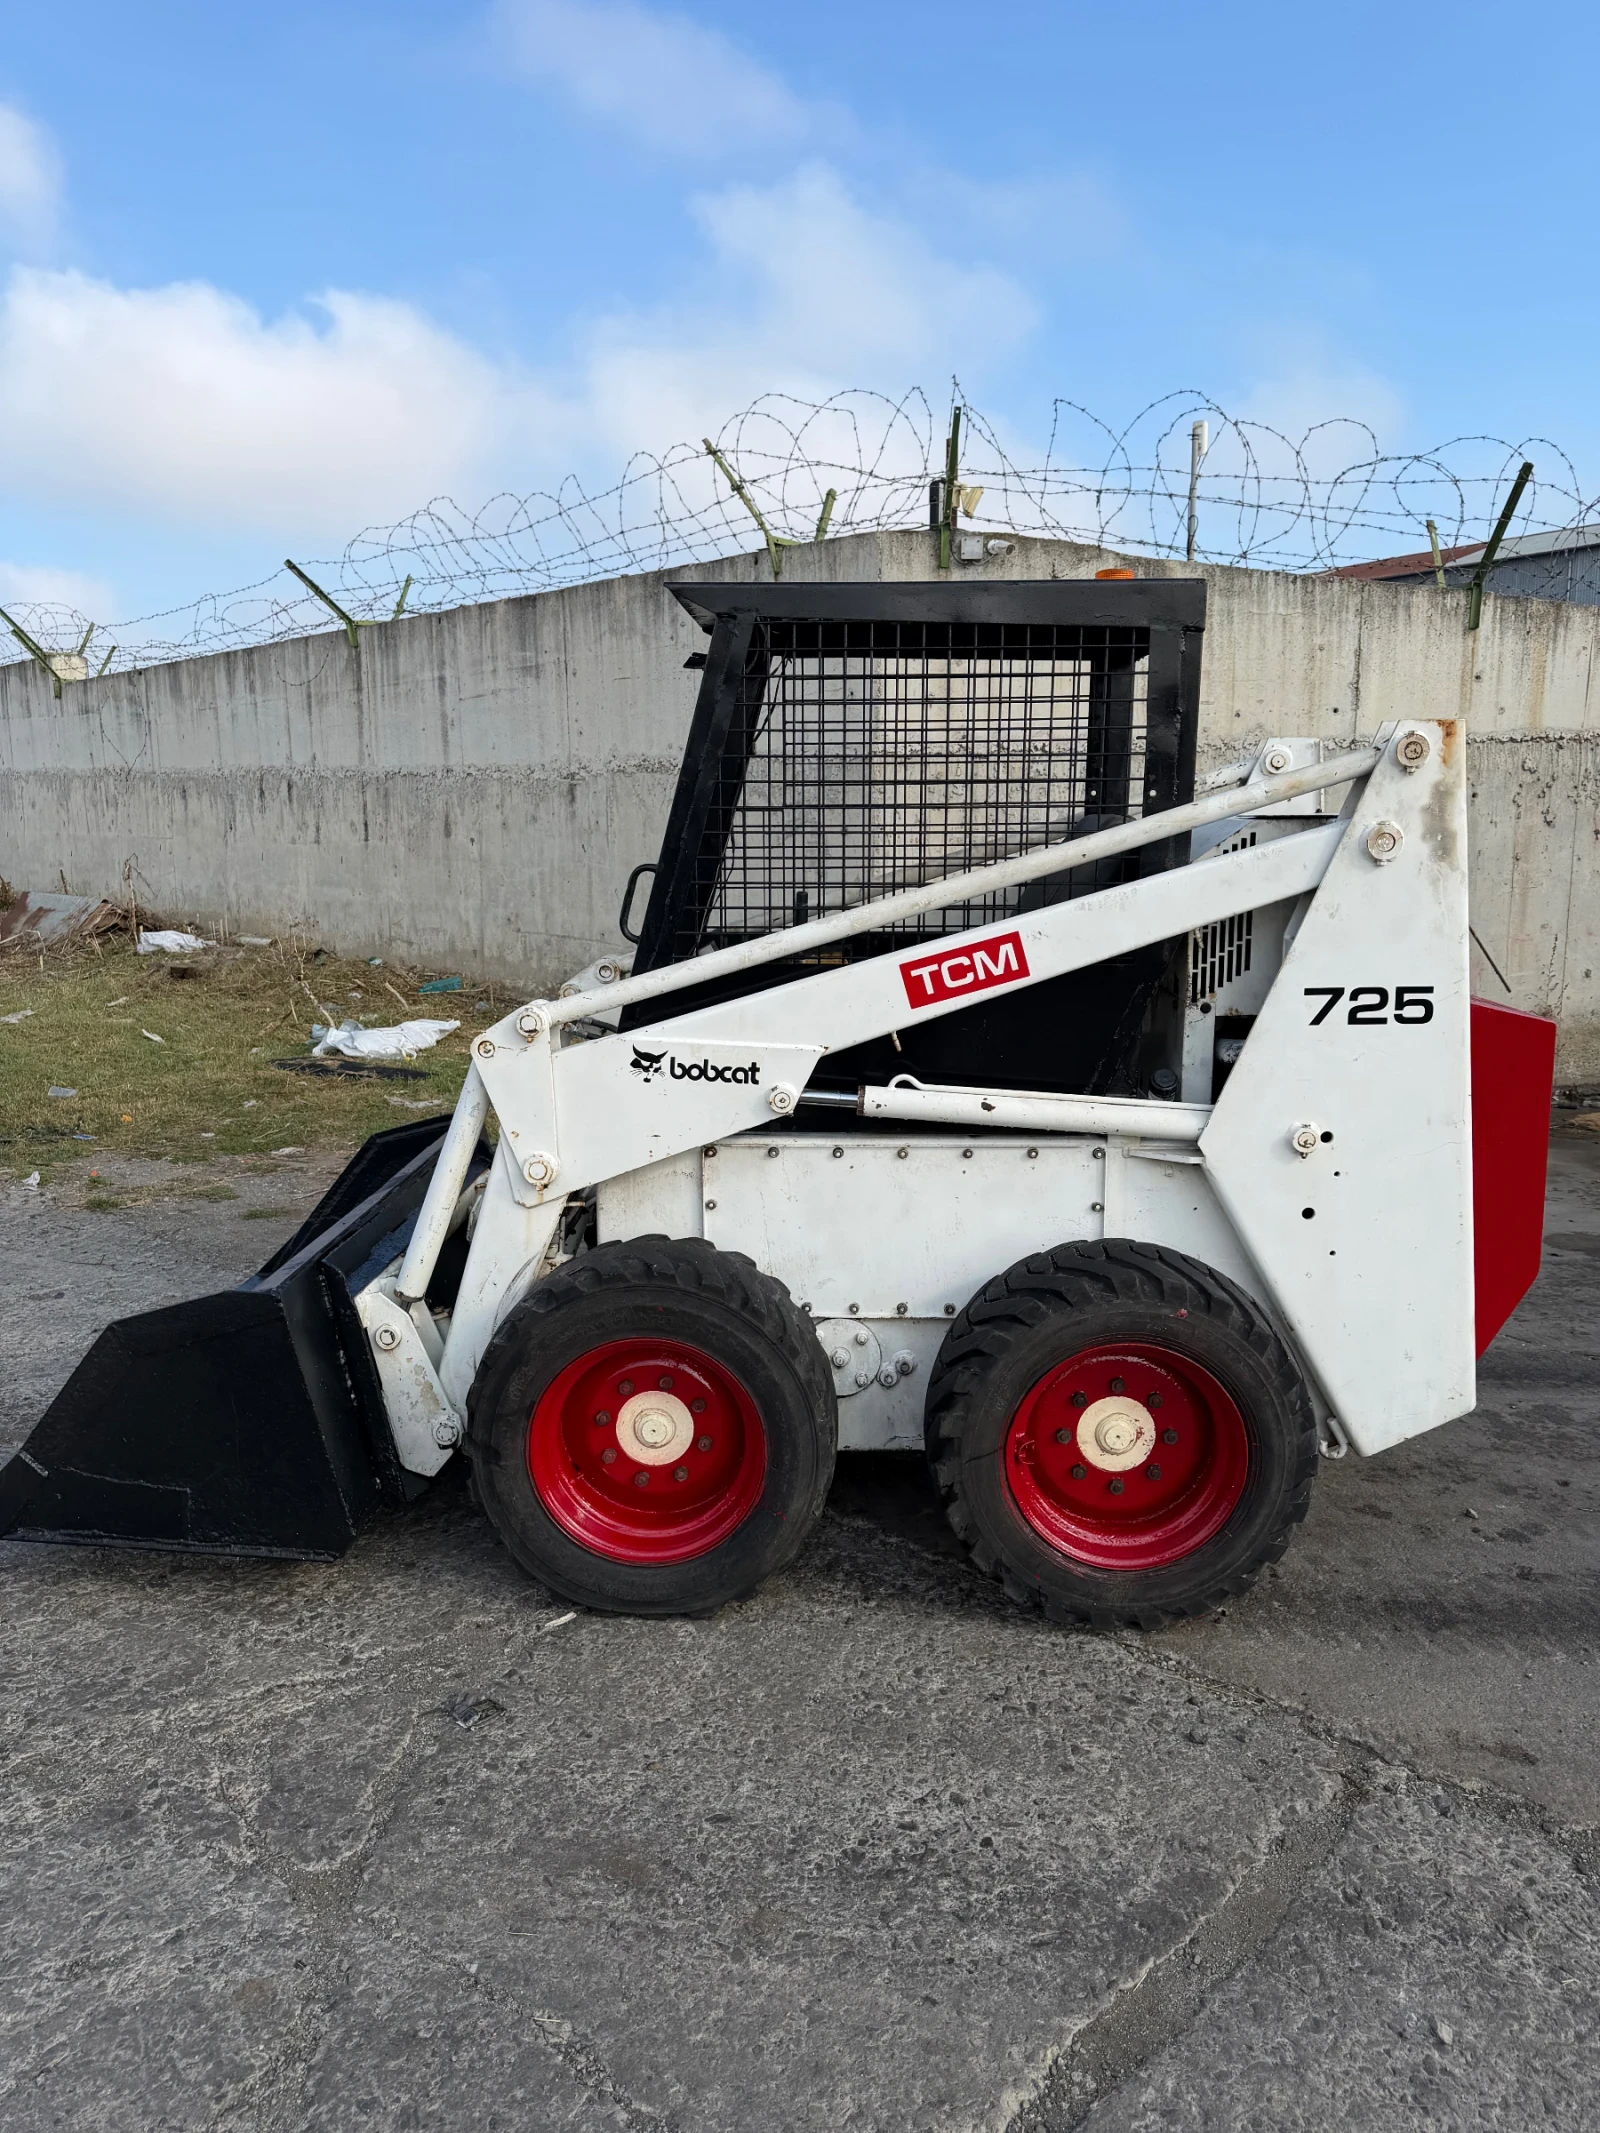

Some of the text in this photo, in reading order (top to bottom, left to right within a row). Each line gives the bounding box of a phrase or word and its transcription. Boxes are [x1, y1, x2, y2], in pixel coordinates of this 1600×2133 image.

[910, 942, 1019, 995] TCM
[1303, 986, 1435, 1026] 725
[669, 1056, 761, 1085] bobcat
